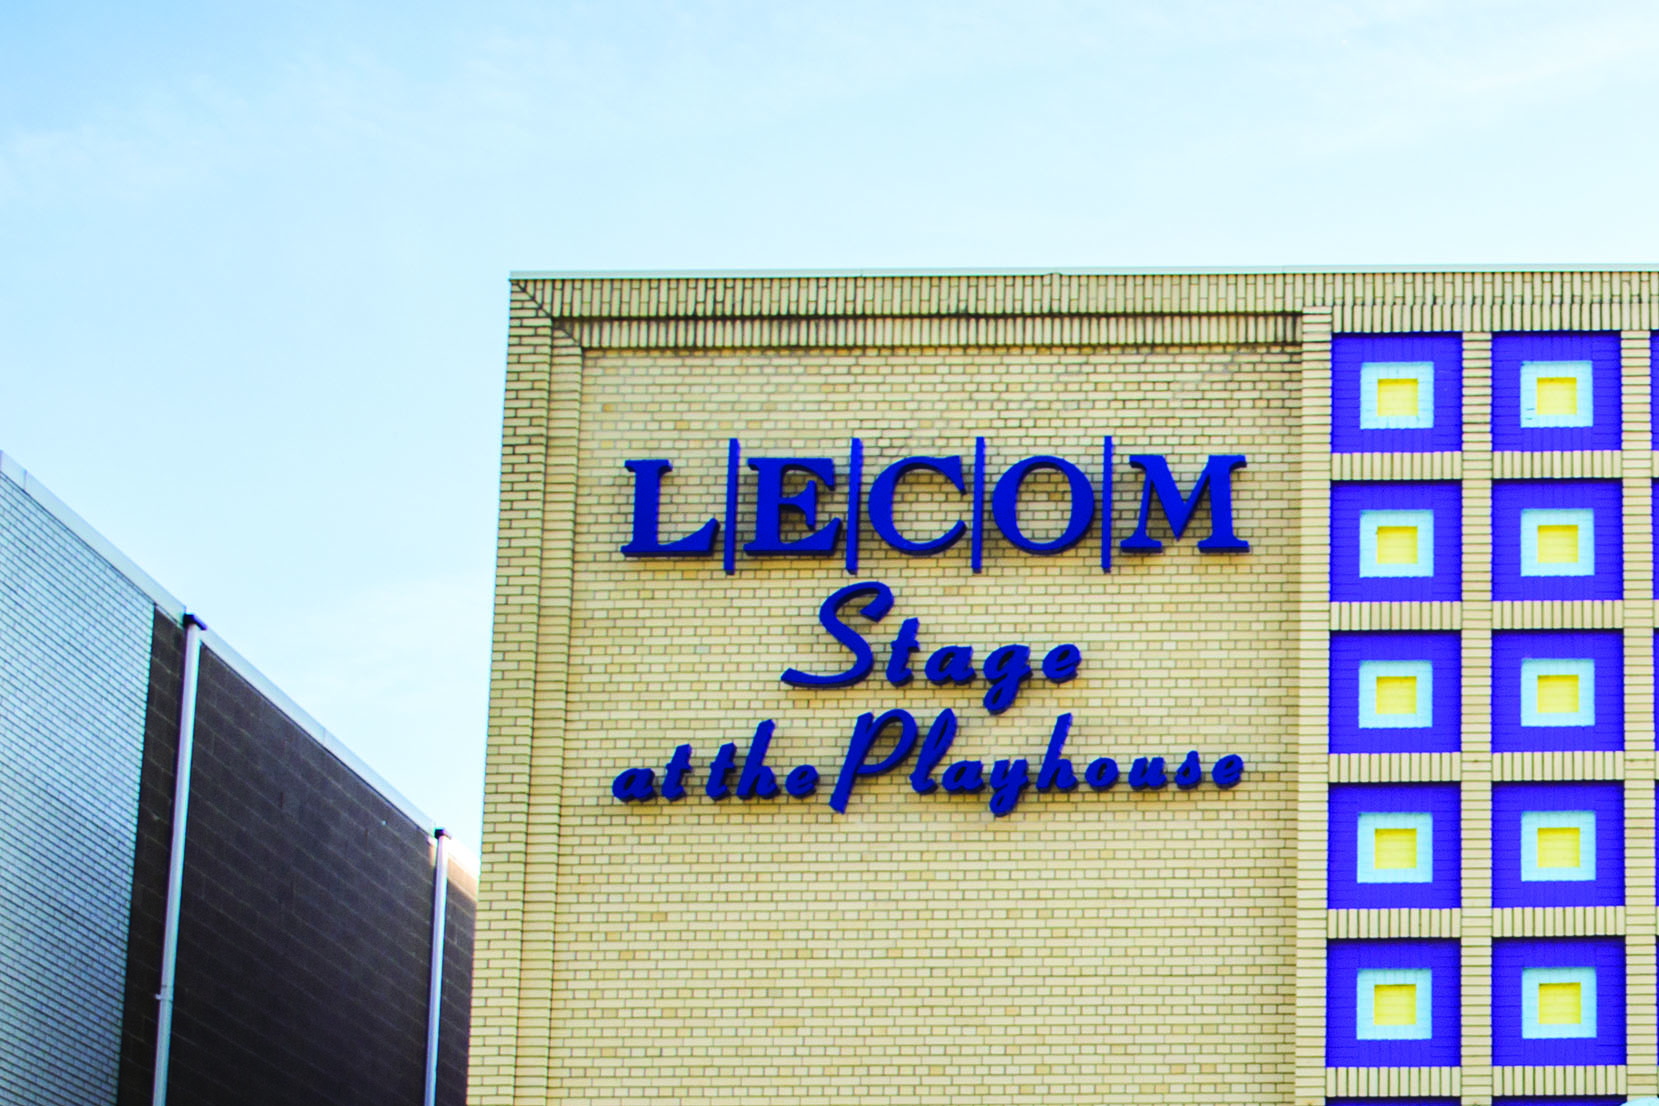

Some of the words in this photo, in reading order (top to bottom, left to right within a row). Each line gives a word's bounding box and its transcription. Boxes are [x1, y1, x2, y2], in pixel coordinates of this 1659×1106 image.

[781, 580, 1082, 714] Stage
[611, 743, 693, 802] at
[704, 718, 819, 800] the
[829, 707, 1245, 817] Playhouse
